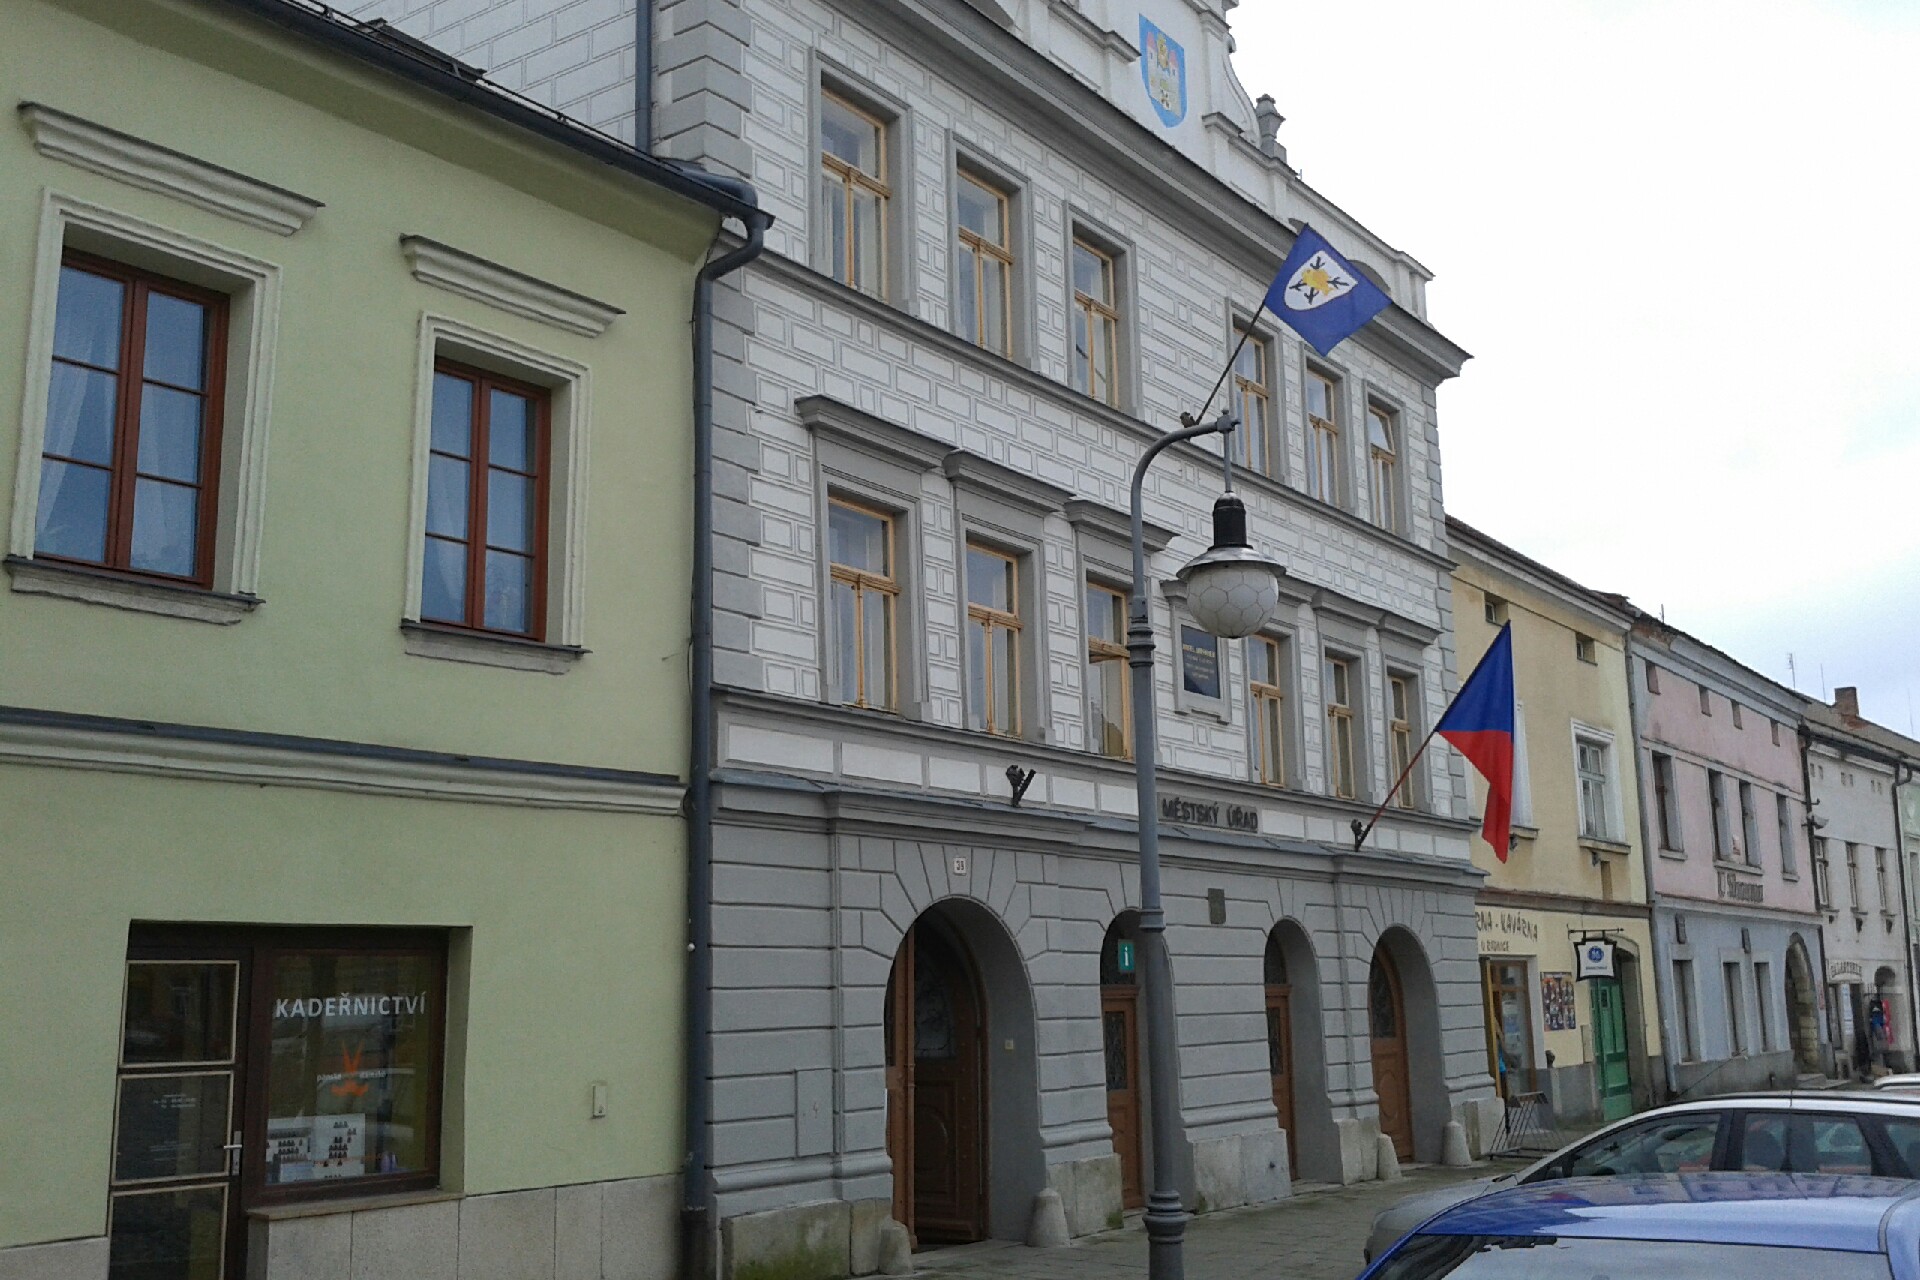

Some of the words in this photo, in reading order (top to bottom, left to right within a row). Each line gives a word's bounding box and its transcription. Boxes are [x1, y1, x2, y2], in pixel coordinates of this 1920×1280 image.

[1162, 797, 1219, 825] MĚSTSKÝ
[1226, 804, 1258, 829] ÚŘAD
[1500, 911, 1538, 942] KAVÁRNA
[275, 991, 427, 1018] KADEŘNICTVÍ
